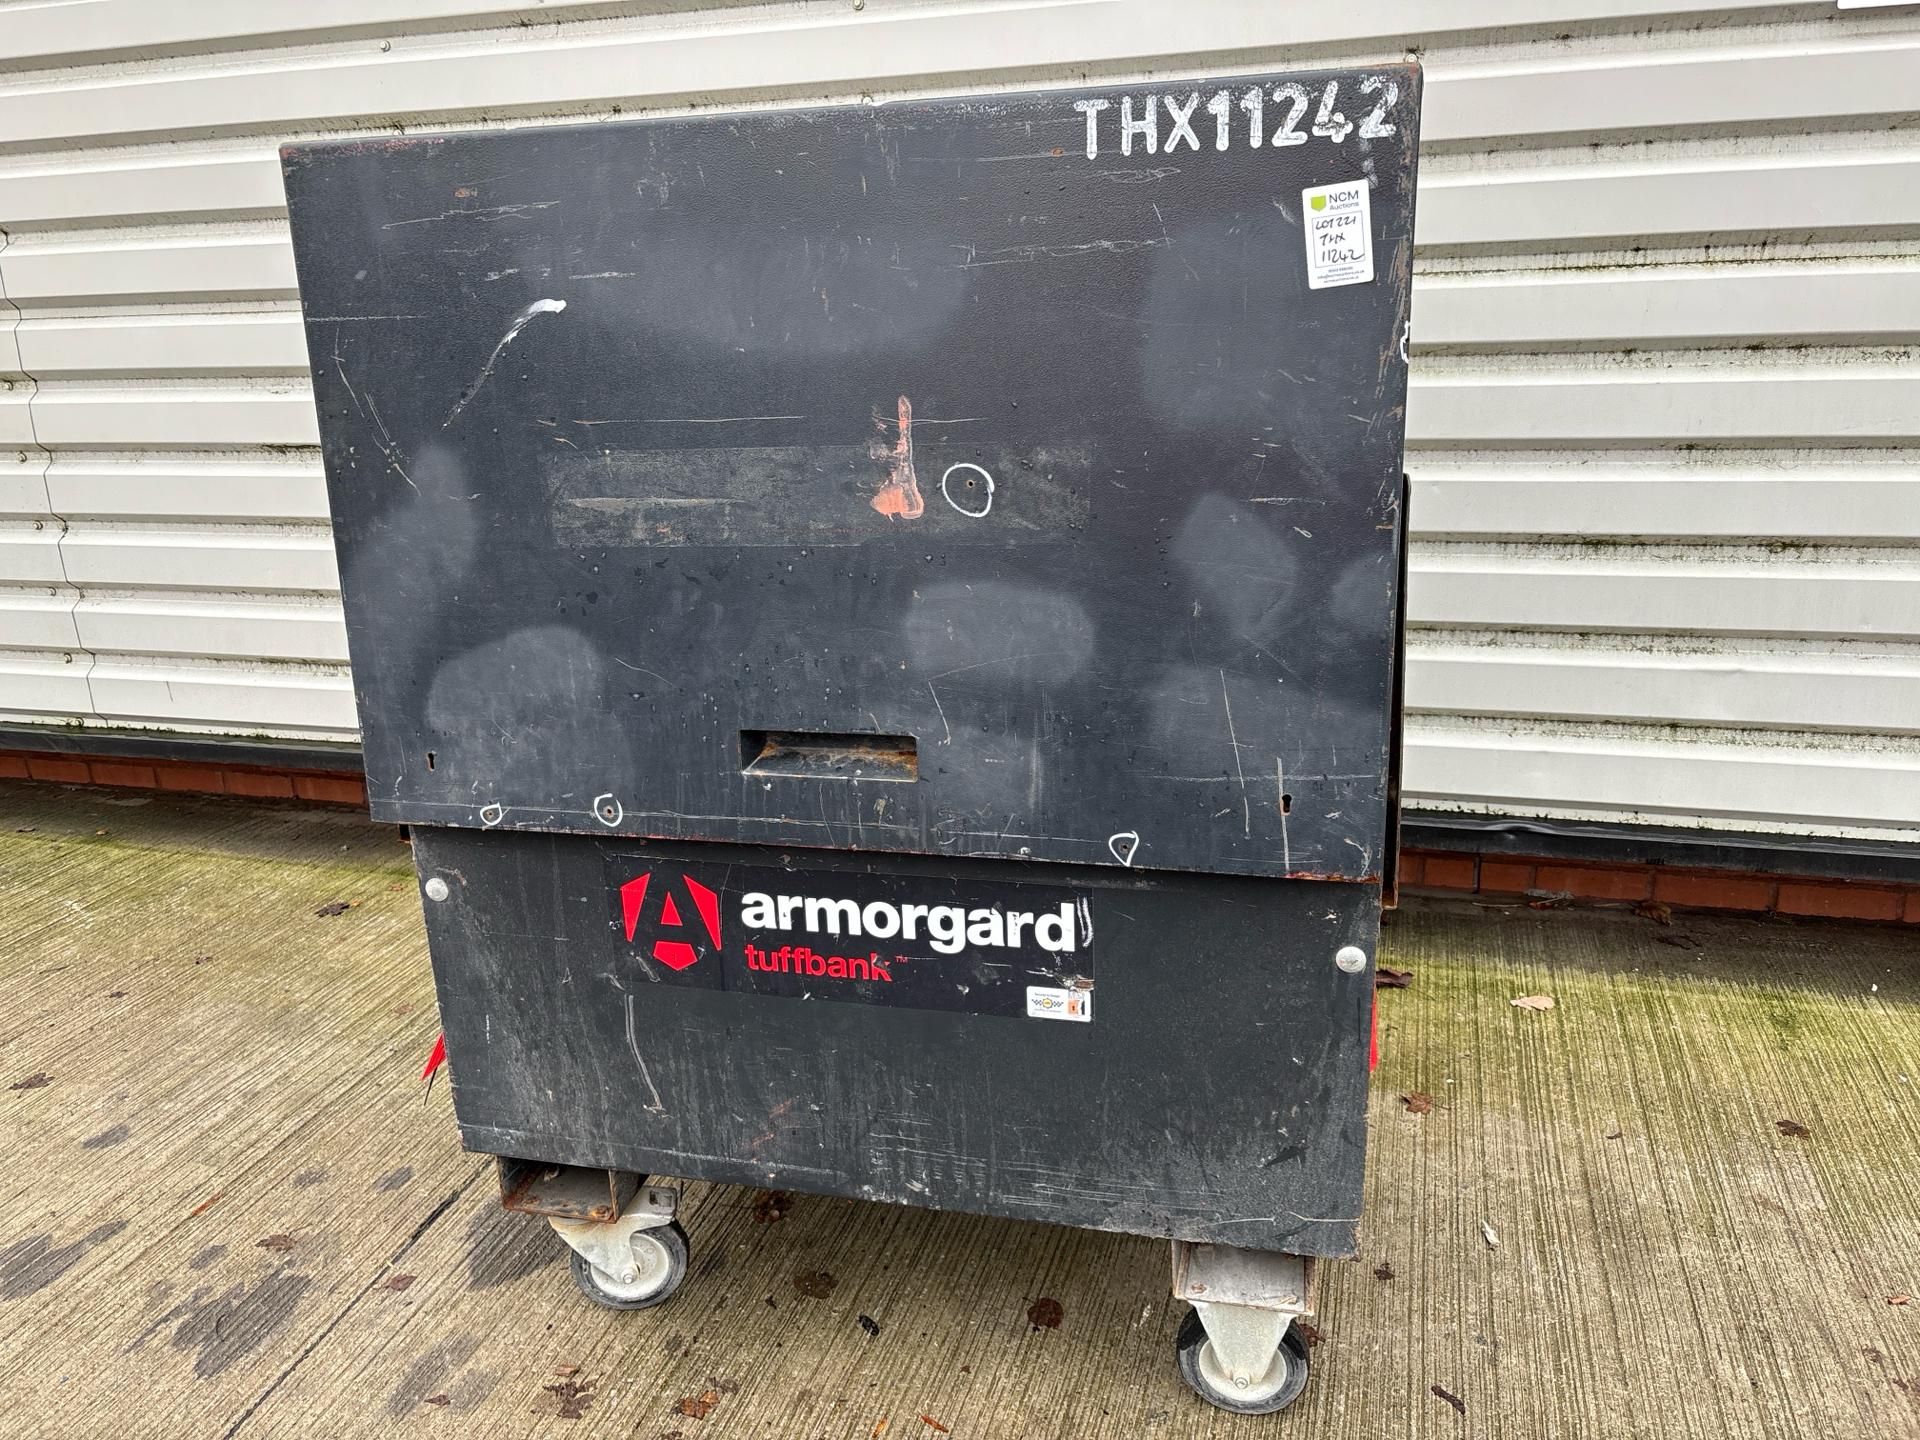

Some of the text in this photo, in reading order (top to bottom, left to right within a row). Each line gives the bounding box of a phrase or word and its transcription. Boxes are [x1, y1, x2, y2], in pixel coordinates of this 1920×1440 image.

[1074, 75, 1398, 159] THX11242
[1329, 190, 1359, 203] NCM
[1329, 202, 1360, 211] Auctions
[1335, 216, 1357, 227] 221
[1322, 248, 1365, 263] 11242
[741, 892, 1076, 954] armorgard
[744, 944, 893, 982] tuffbank
